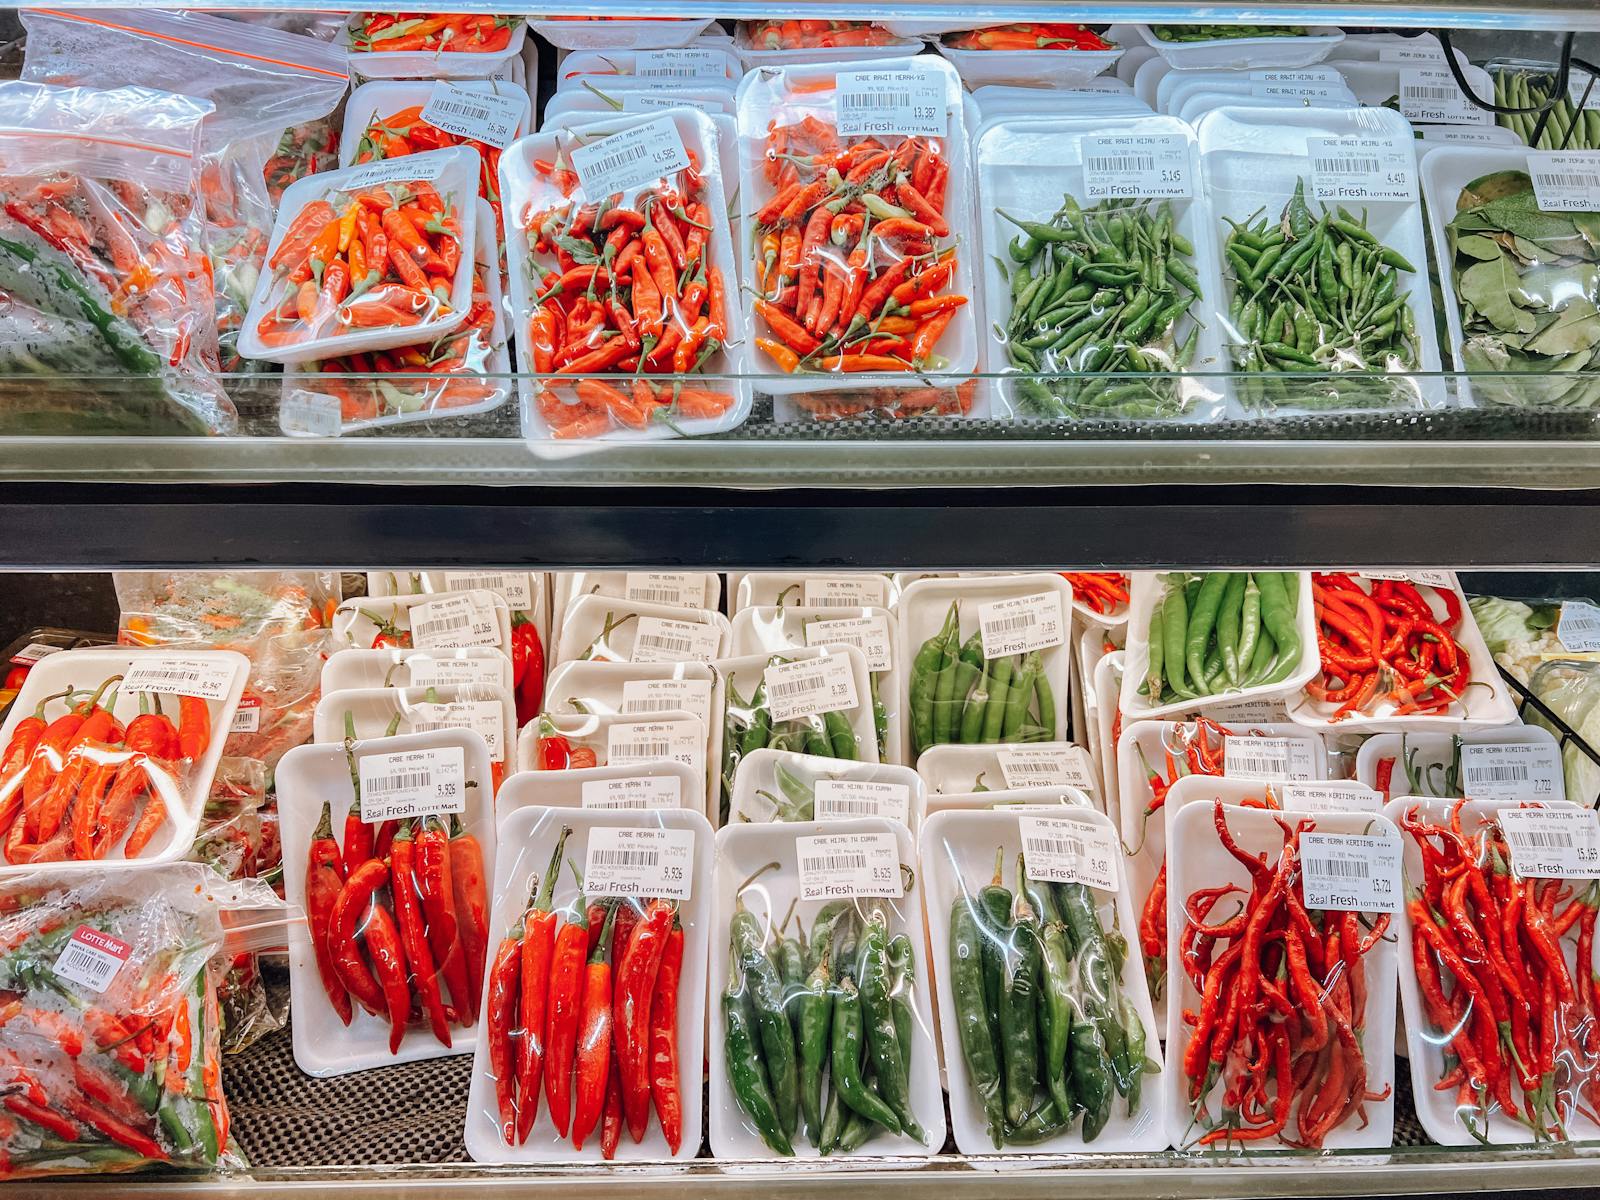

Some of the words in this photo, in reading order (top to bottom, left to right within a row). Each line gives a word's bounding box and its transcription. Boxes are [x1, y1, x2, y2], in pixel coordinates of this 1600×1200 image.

[1404, 110, 1419, 118] Real
[1421, 110, 1445, 119] Fresh
[843, 123, 861, 132] Real
[864, 122, 894, 131] Fresh
[441, 123, 467, 133] Fresh
[490, 137, 504, 146] Mart
[1089, 186, 1108, 195] Real
[1111, 185, 1140, 194] Fresh
[1318, 188, 1335, 197] Real
[1339, 188, 1367, 196] Fresh
[1543, 199, 1560, 207] Real
[1563, 199, 1591, 208] Fresh
[987, 647, 1004, 656] Real
[1004, 642, 1026, 652] Fresh
[775, 708, 791, 718] Real
[792, 703, 816, 714] Fresh
[366, 809, 384, 819] Real
[387, 804, 415, 816] Fresh
[1031, 867, 1048, 877] Real
[1051, 869, 1077, 878] Fresh
[1520, 863, 1535, 872] Real
[1538, 864, 1563, 873] Fresh
[587, 882, 606, 892] Real
[610, 882, 639, 892] Fresh
[805, 888, 822, 897] Real
[825, 885, 853, 895] Fresh
[1309, 894, 1327, 904] Real
[1331, 895, 1357, 906] Fresh
[81, 931, 105, 946] LOTTE
[104, 938, 123, 954] Mart
